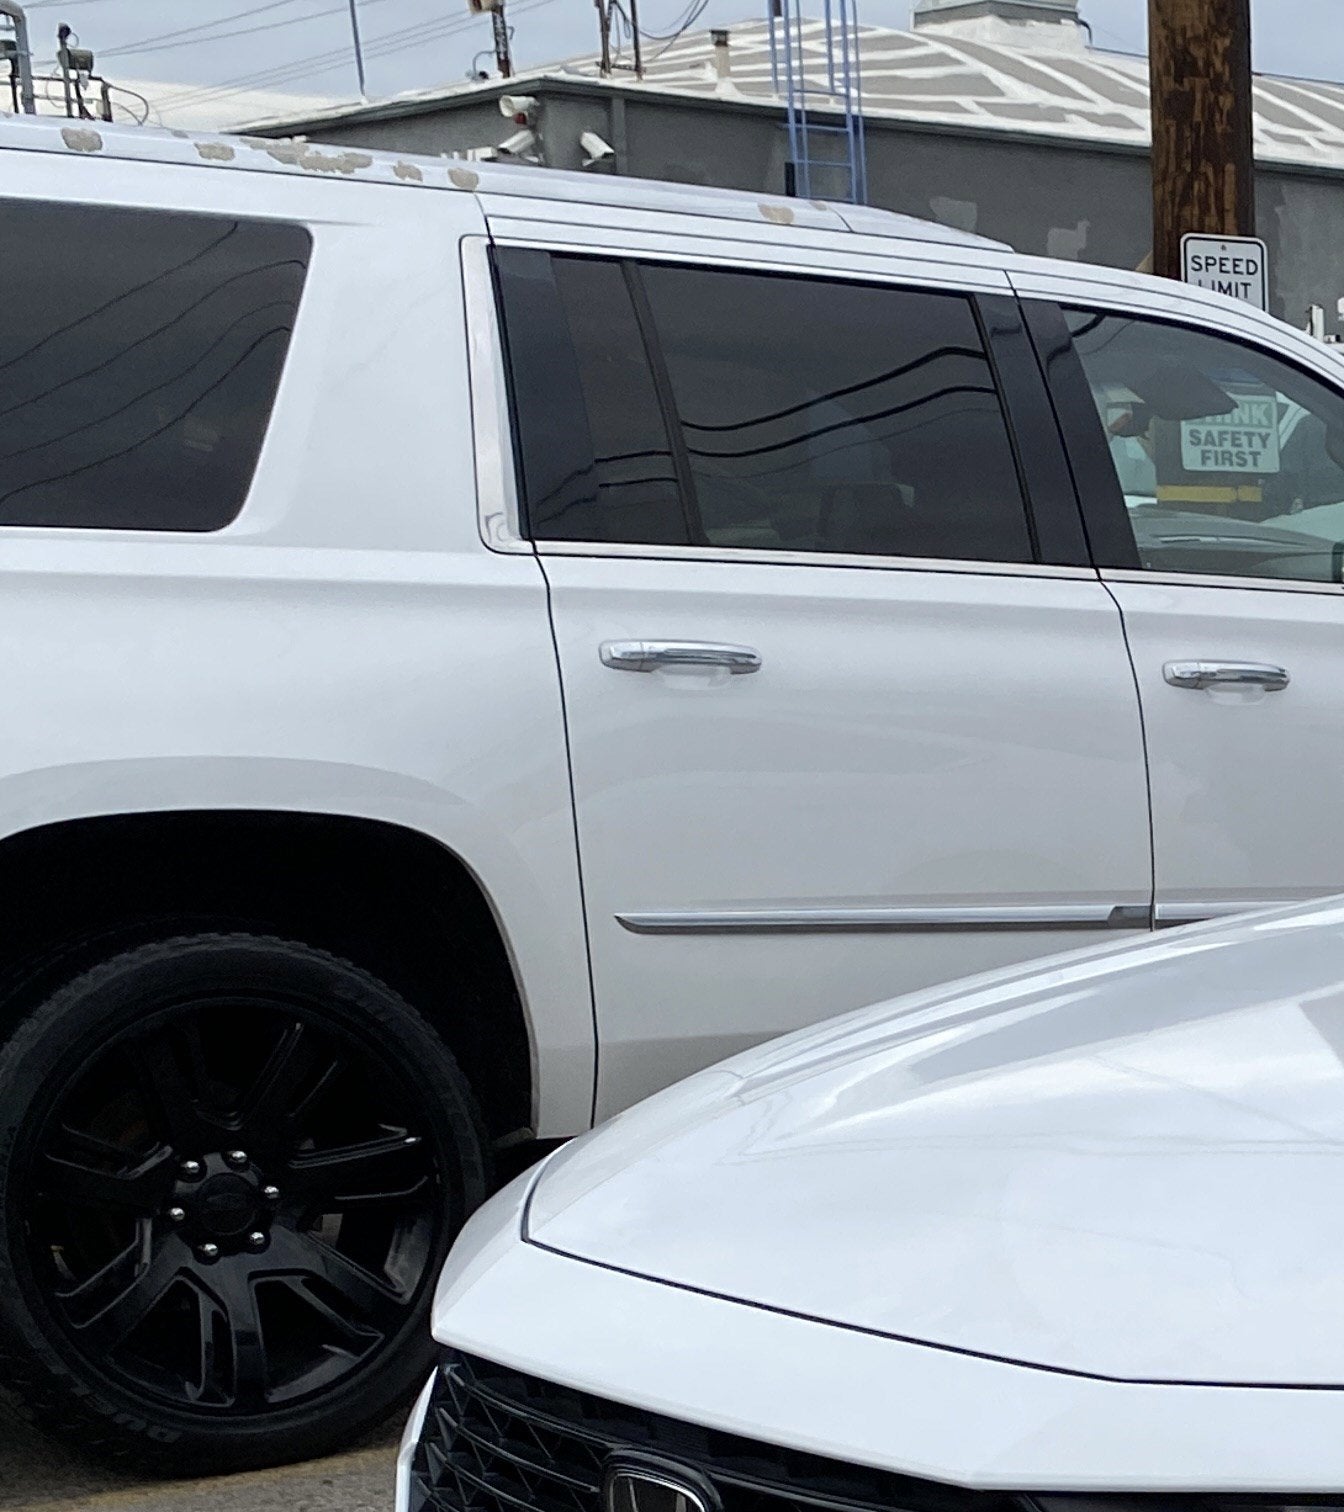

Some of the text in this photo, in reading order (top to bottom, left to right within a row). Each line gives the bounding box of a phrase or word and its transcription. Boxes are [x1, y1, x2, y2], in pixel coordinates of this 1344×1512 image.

[1191, 254, 1258, 276] SPEED
[1189, 428, 1271, 450] SAFETY
[1201, 448, 1262, 468] FIRST
